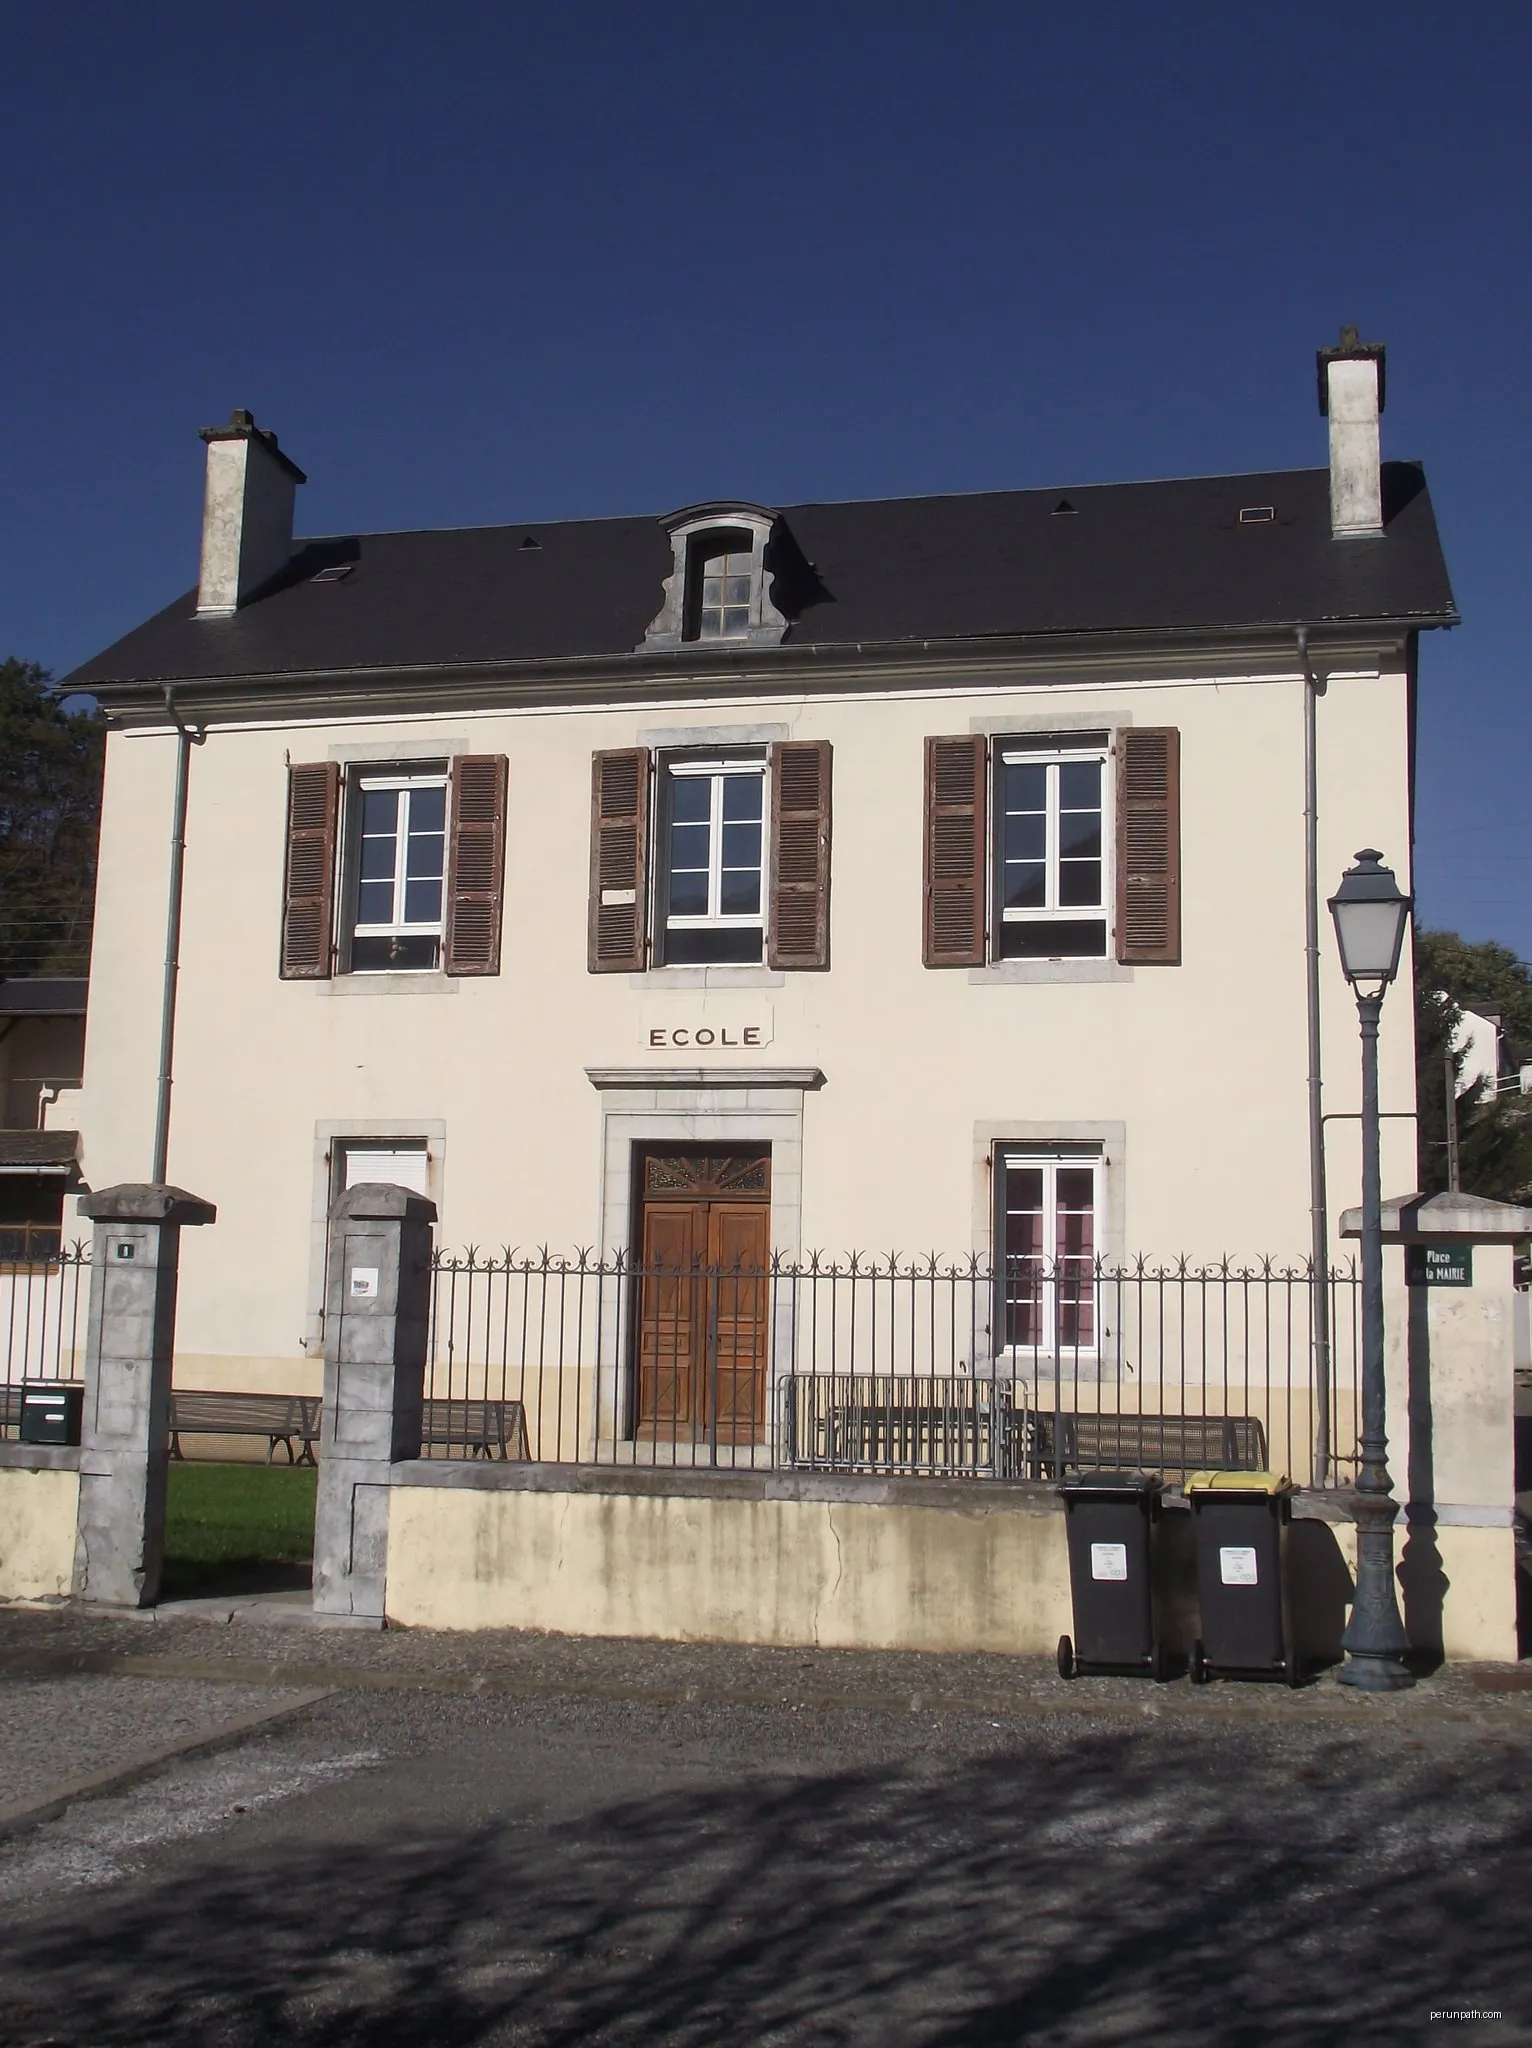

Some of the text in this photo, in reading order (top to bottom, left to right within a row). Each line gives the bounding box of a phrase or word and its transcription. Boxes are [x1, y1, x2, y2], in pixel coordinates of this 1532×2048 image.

[650, 1027, 761, 1046] ECOLE
[1427, 1250, 1450, 1263] Place
[1426, 1267, 1434, 1280] la
[1436, 1267, 1465, 1280] MAIRIE
